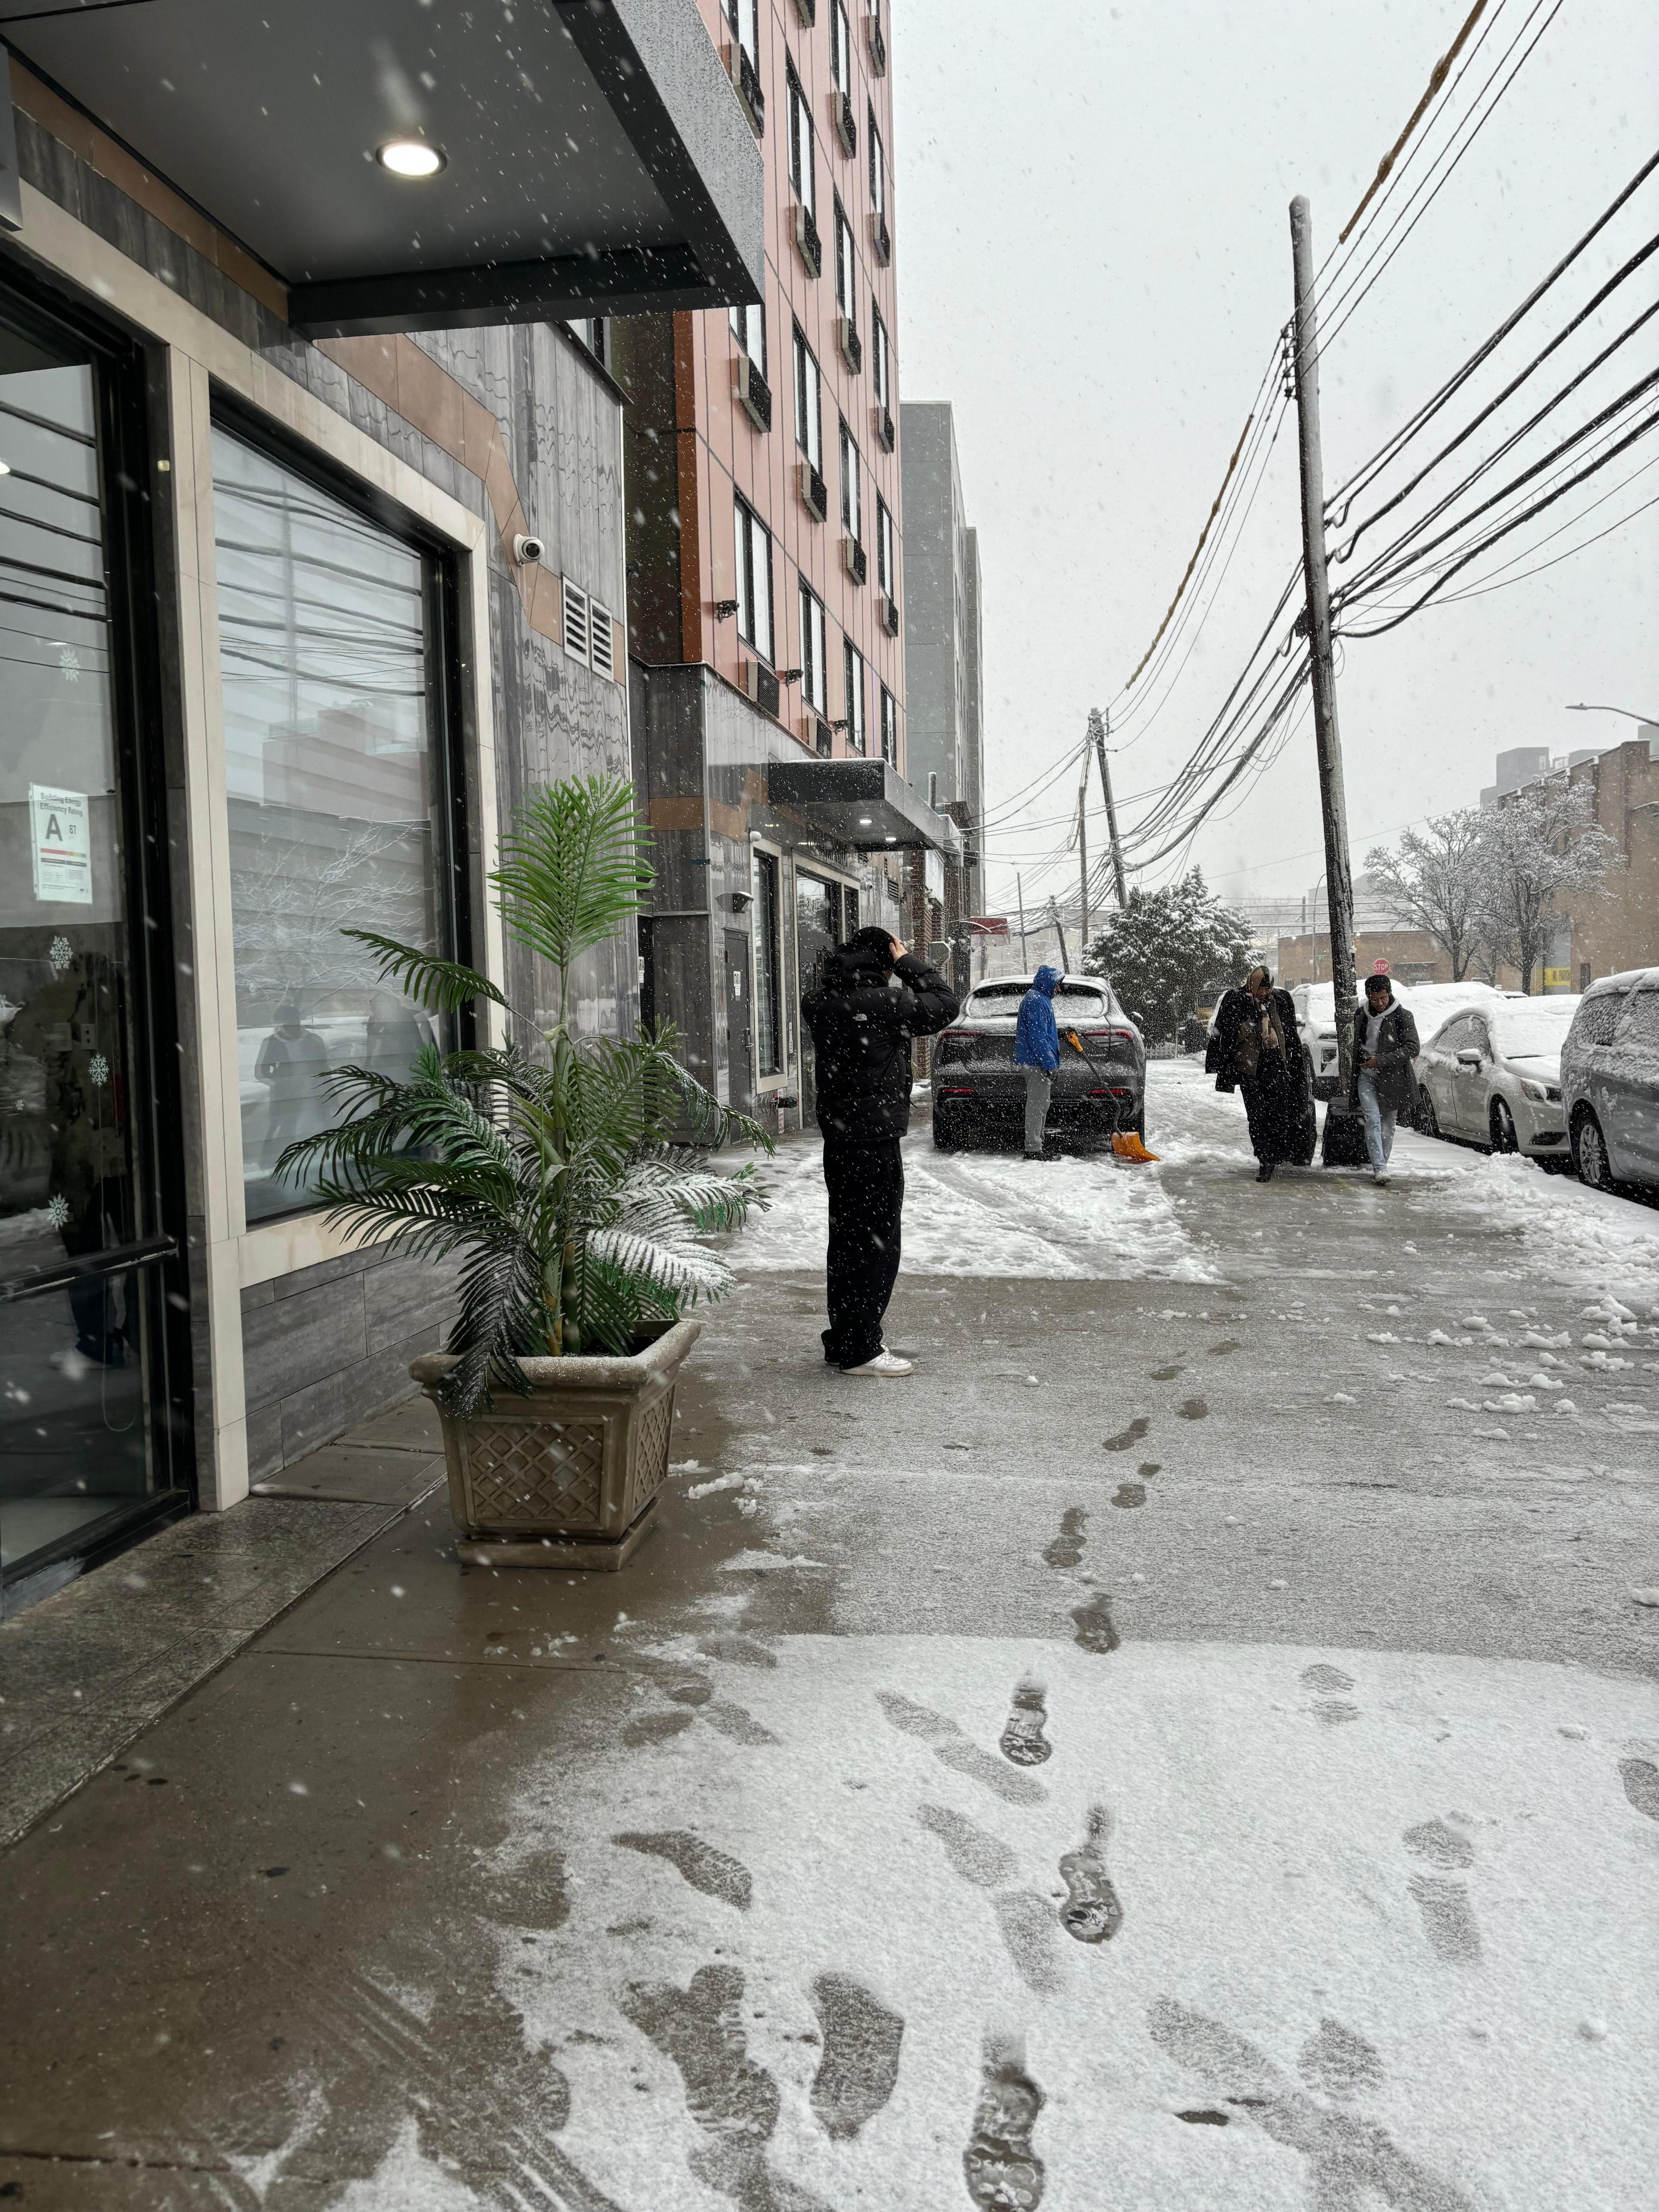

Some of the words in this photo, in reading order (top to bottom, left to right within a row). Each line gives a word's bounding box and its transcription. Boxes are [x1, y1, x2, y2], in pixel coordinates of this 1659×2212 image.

[65, 797, 81, 807] Energy
[40, 802, 67, 814] Efficiency
[68, 807, 83, 817] Rating
[45, 814, 63, 841] A
[69, 824, 76, 835] 87
